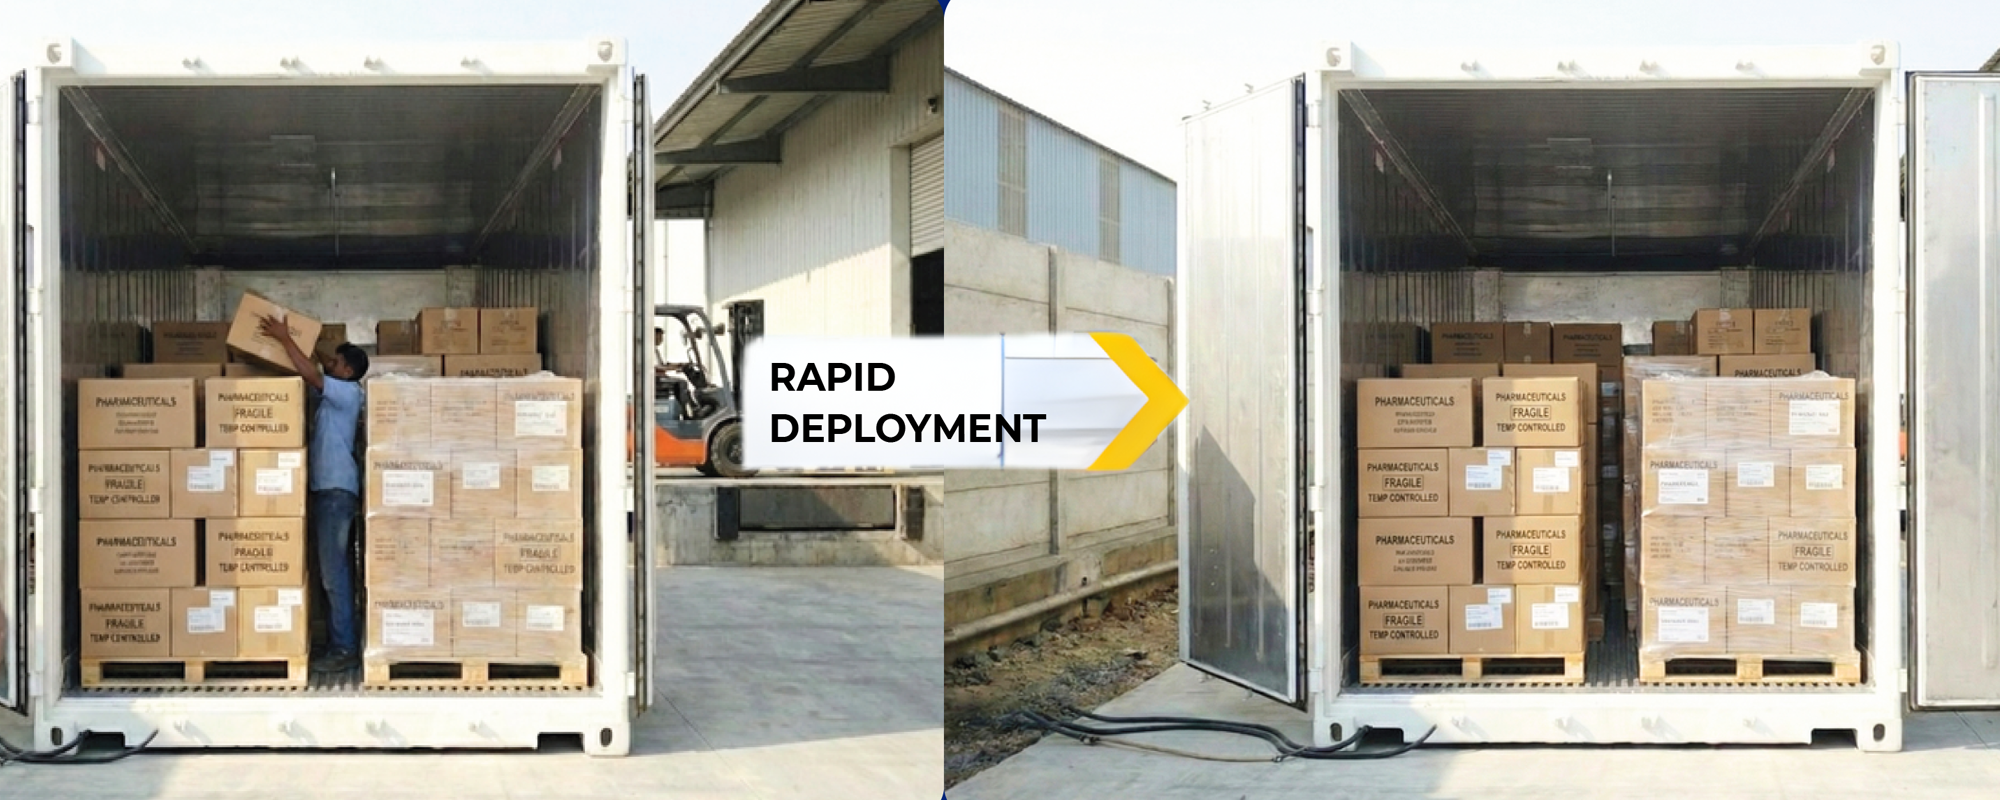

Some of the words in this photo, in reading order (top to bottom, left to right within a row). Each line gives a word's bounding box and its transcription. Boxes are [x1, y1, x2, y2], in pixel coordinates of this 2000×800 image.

[1735, 368, 1801, 377] PHARMACEUTICALS
[1496, 392, 1566, 402] PHARMACEUTICALS
[1779, 391, 1849, 401] PHARMACEUTICALS
[1375, 396, 1455, 407] PHARMACEUTICALS
[1512, 407, 1550, 418] FRAGILE
[1496, 423, 1516, 432] TEMP
[1518, 423, 1566, 432] CONTROLLED
[1367, 462, 1439, 472] PHARMACEUTICALS
[1650, 460, 1718, 469] PHARMACEUTICALS
[1384, 477, 1422, 488] FRAGILE
[1368, 493, 1388, 502] TEMP
[1390, 493, 1439, 502] CONTROLLED
[1496, 530, 1566, 539] PHARMACEUTICALS
[1778, 530, 1848, 541] PHARMACEUTICALS
[1375, 535, 1455, 545] PHARMACEUTICALS
[1512, 545, 1550, 555] FRAGILE
[1795, 546, 1832, 557] FRAGILE
[1496, 560, 1516, 570] TEMP
[1518, 560, 1566, 570] CONTROLLED
[1778, 561, 1798, 572] TEMP
[1799, 561, 1848, 572] CONTROLLED
[1368, 599, 1439, 609] PHARMACEUTICALS
[1649, 597, 1719, 607] PHARMACEUTICALS
[1385, 614, 1423, 625] FRAGILE
[1369, 629, 1388, 639] TEMP
[1390, 629, 1439, 639] CONTROLLED
